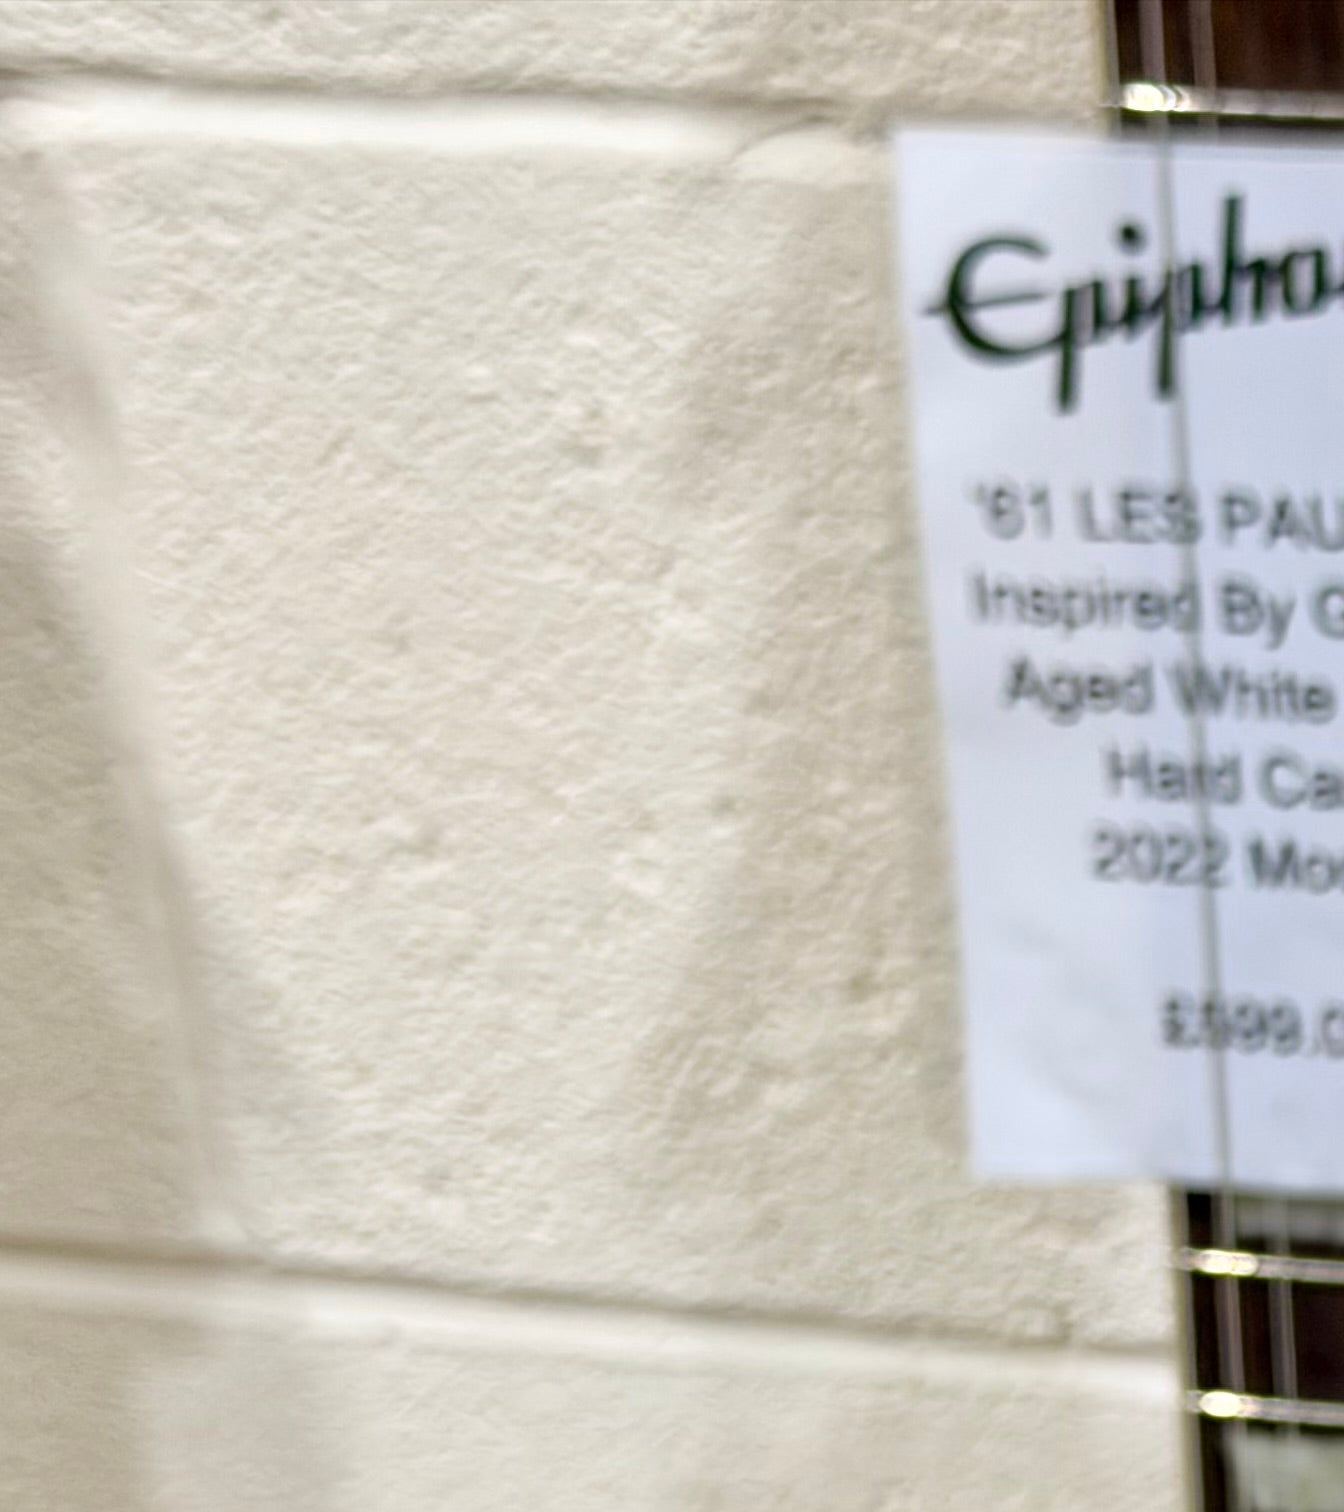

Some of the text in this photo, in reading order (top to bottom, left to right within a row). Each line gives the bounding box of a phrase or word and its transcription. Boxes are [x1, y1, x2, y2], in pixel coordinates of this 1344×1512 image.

[1075, 478, 1203, 546] LES
[971, 571, 1200, 635] Inspired
[1217, 581, 1296, 650] By
[1004, 658, 1154, 727] Aged
[1167, 662, 1339, 723] White
[1108, 749, 1242, 806] Hard
[1093, 829, 1230, 889] 2022
